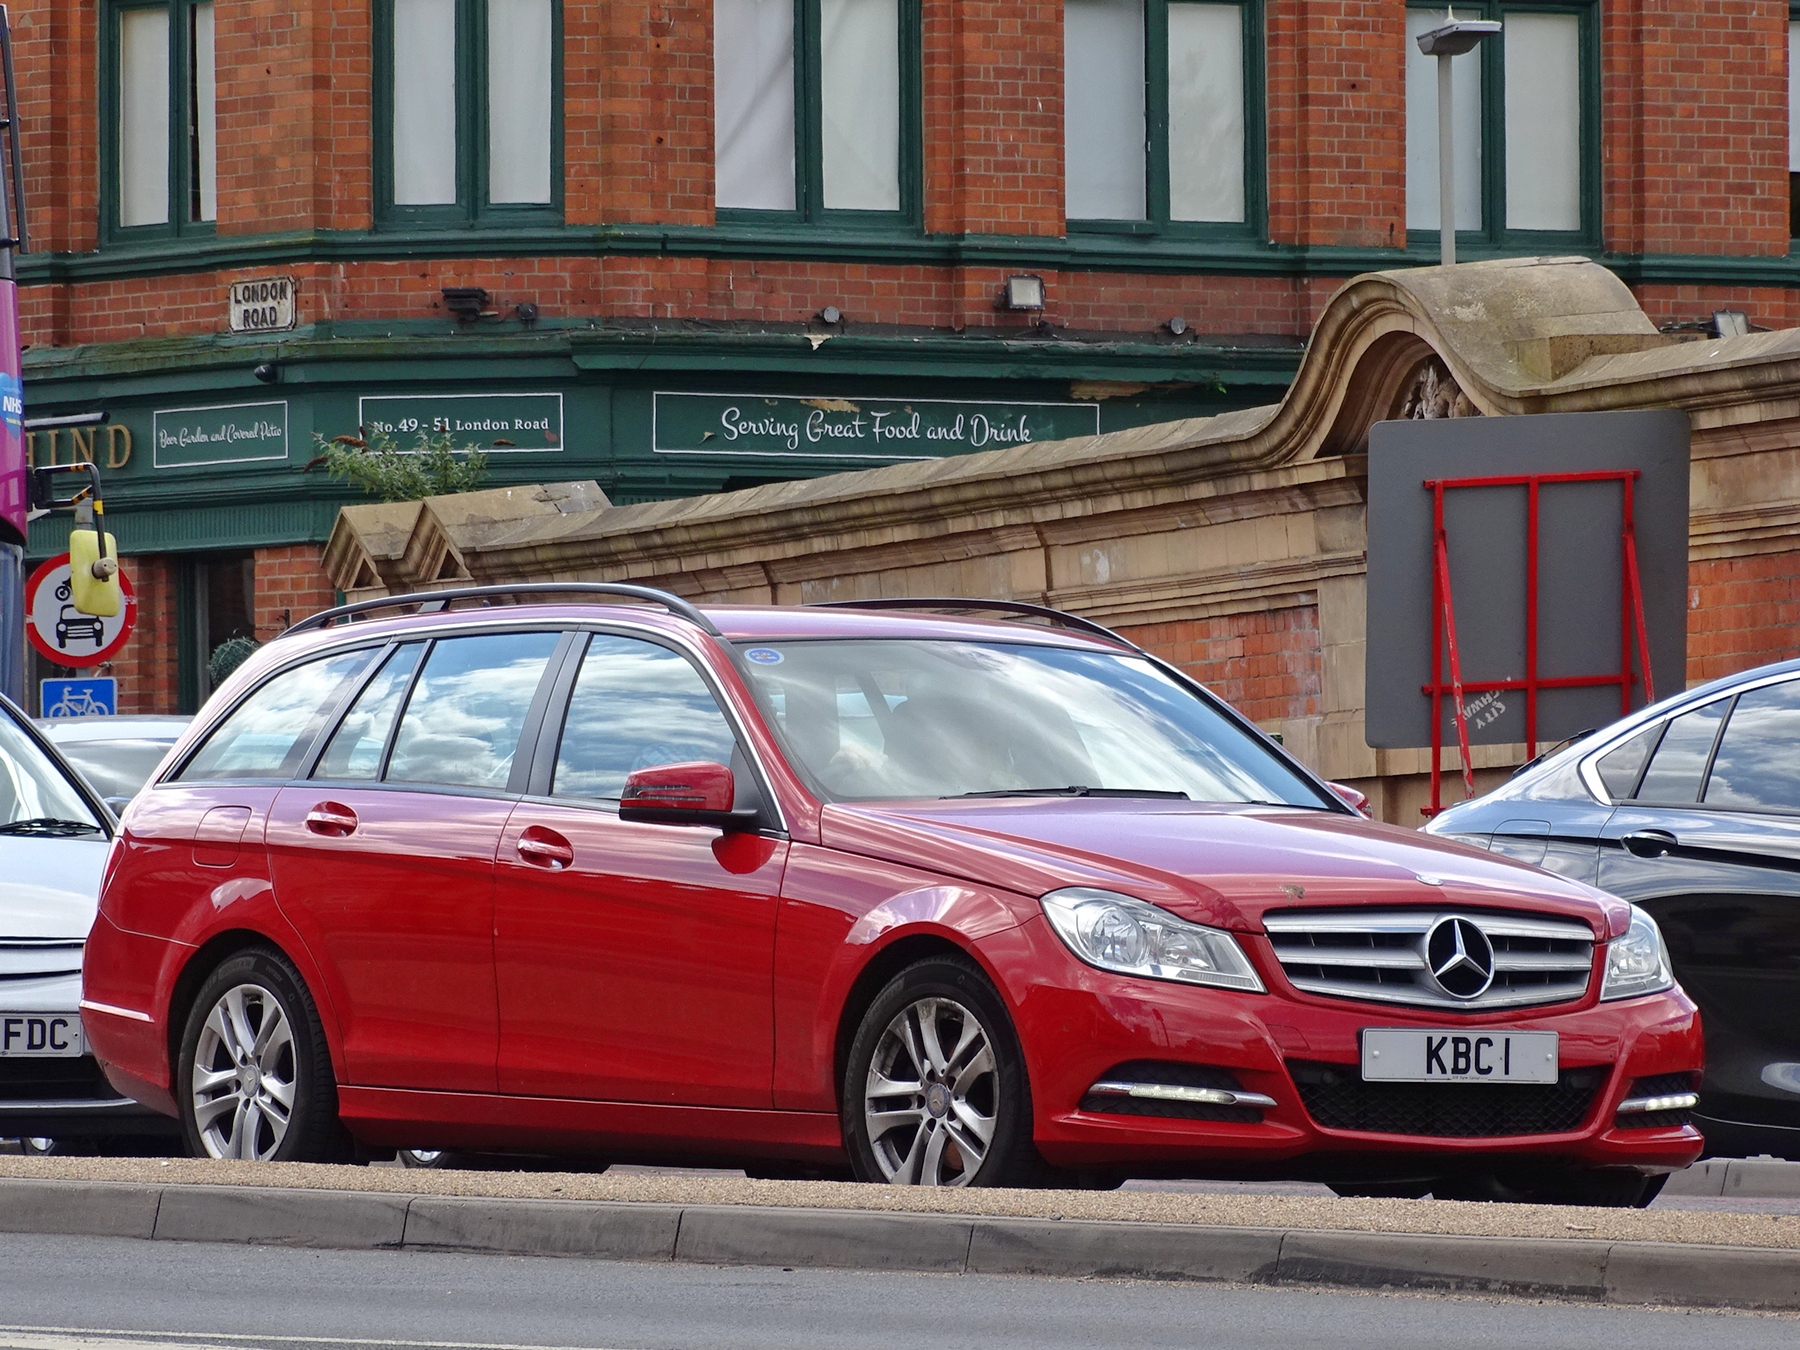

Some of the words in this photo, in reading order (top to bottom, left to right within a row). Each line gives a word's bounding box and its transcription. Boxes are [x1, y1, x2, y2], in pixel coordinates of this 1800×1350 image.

[234, 281, 288, 304] LONDON
[243, 306, 277, 328] ROAD
[3, 395, 22, 415] NHS
[159, 428, 178, 448] Beer
[179, 426, 209, 447] Garden
[210, 425, 226, 442] and
[226, 422, 258, 443] Covered
[260, 421, 282, 440] Patio
[433, 417, 451, 432] 51
[456, 418, 510, 431] London
[514, 418, 549, 430] Road
[721, 406, 799, 450] Serving
[806, 409, 868, 443] Great
[870, 411, 921, 443] Food
[926, 413, 965, 440] and
[970, 413, 1033, 447] Drink
[1476, 700, 1506, 729] CITY
[4, 1018, 68, 1050] FDC
[1426, 1036, 1493, 1075] KBC
